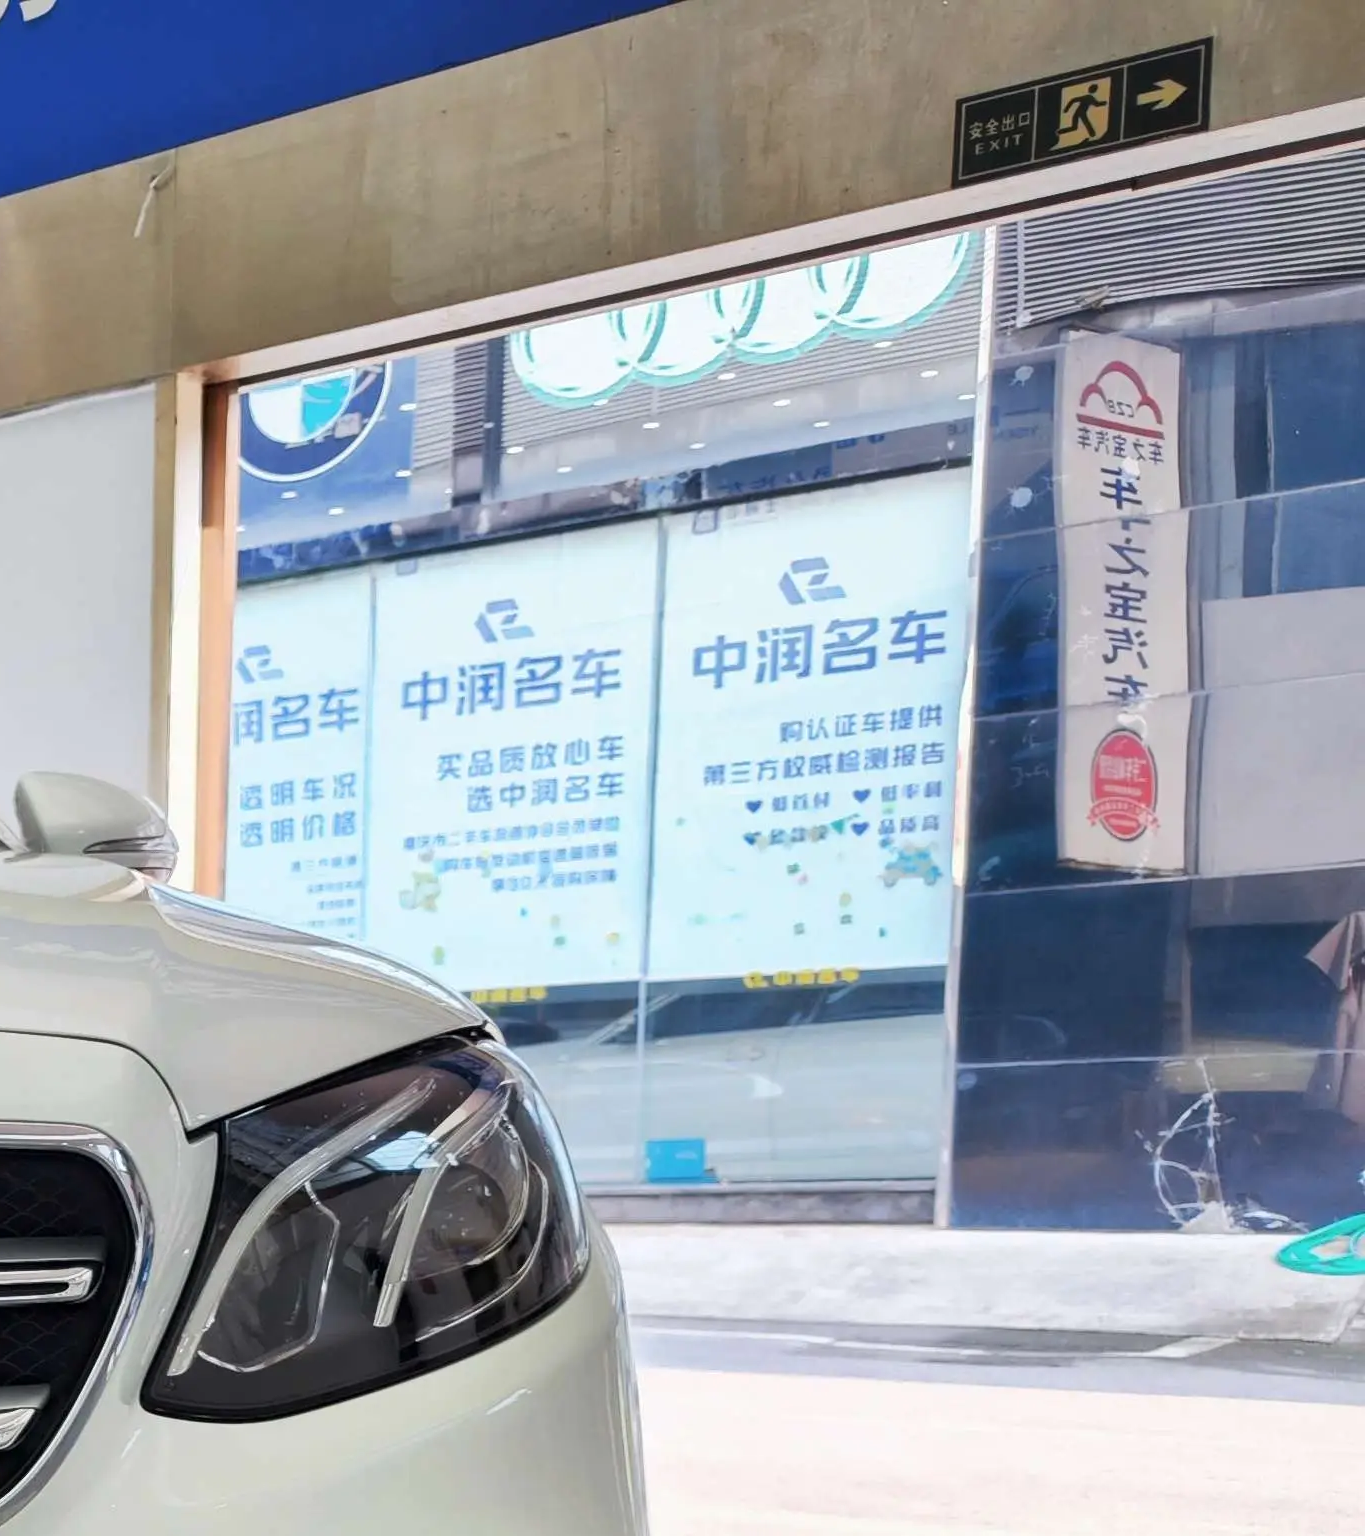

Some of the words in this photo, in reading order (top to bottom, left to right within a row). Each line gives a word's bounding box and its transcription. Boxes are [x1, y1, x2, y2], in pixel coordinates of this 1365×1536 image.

[969, 112, 1031, 140] 安全出口
[975, 133, 1024, 155] EXIT
[692, 610, 948, 690] 中润名车
[400, 648, 624, 722] 中润名车
[779, 704, 944, 744] 购认证车提供
[436, 735, 625, 782] 买品质放心车
[703, 742, 946, 787] 第三方权威检测报告
[239, 772, 357, 811] 透明车况
[466, 772, 625, 813] 选中润名车
[239, 810, 357, 848] 透明价格
